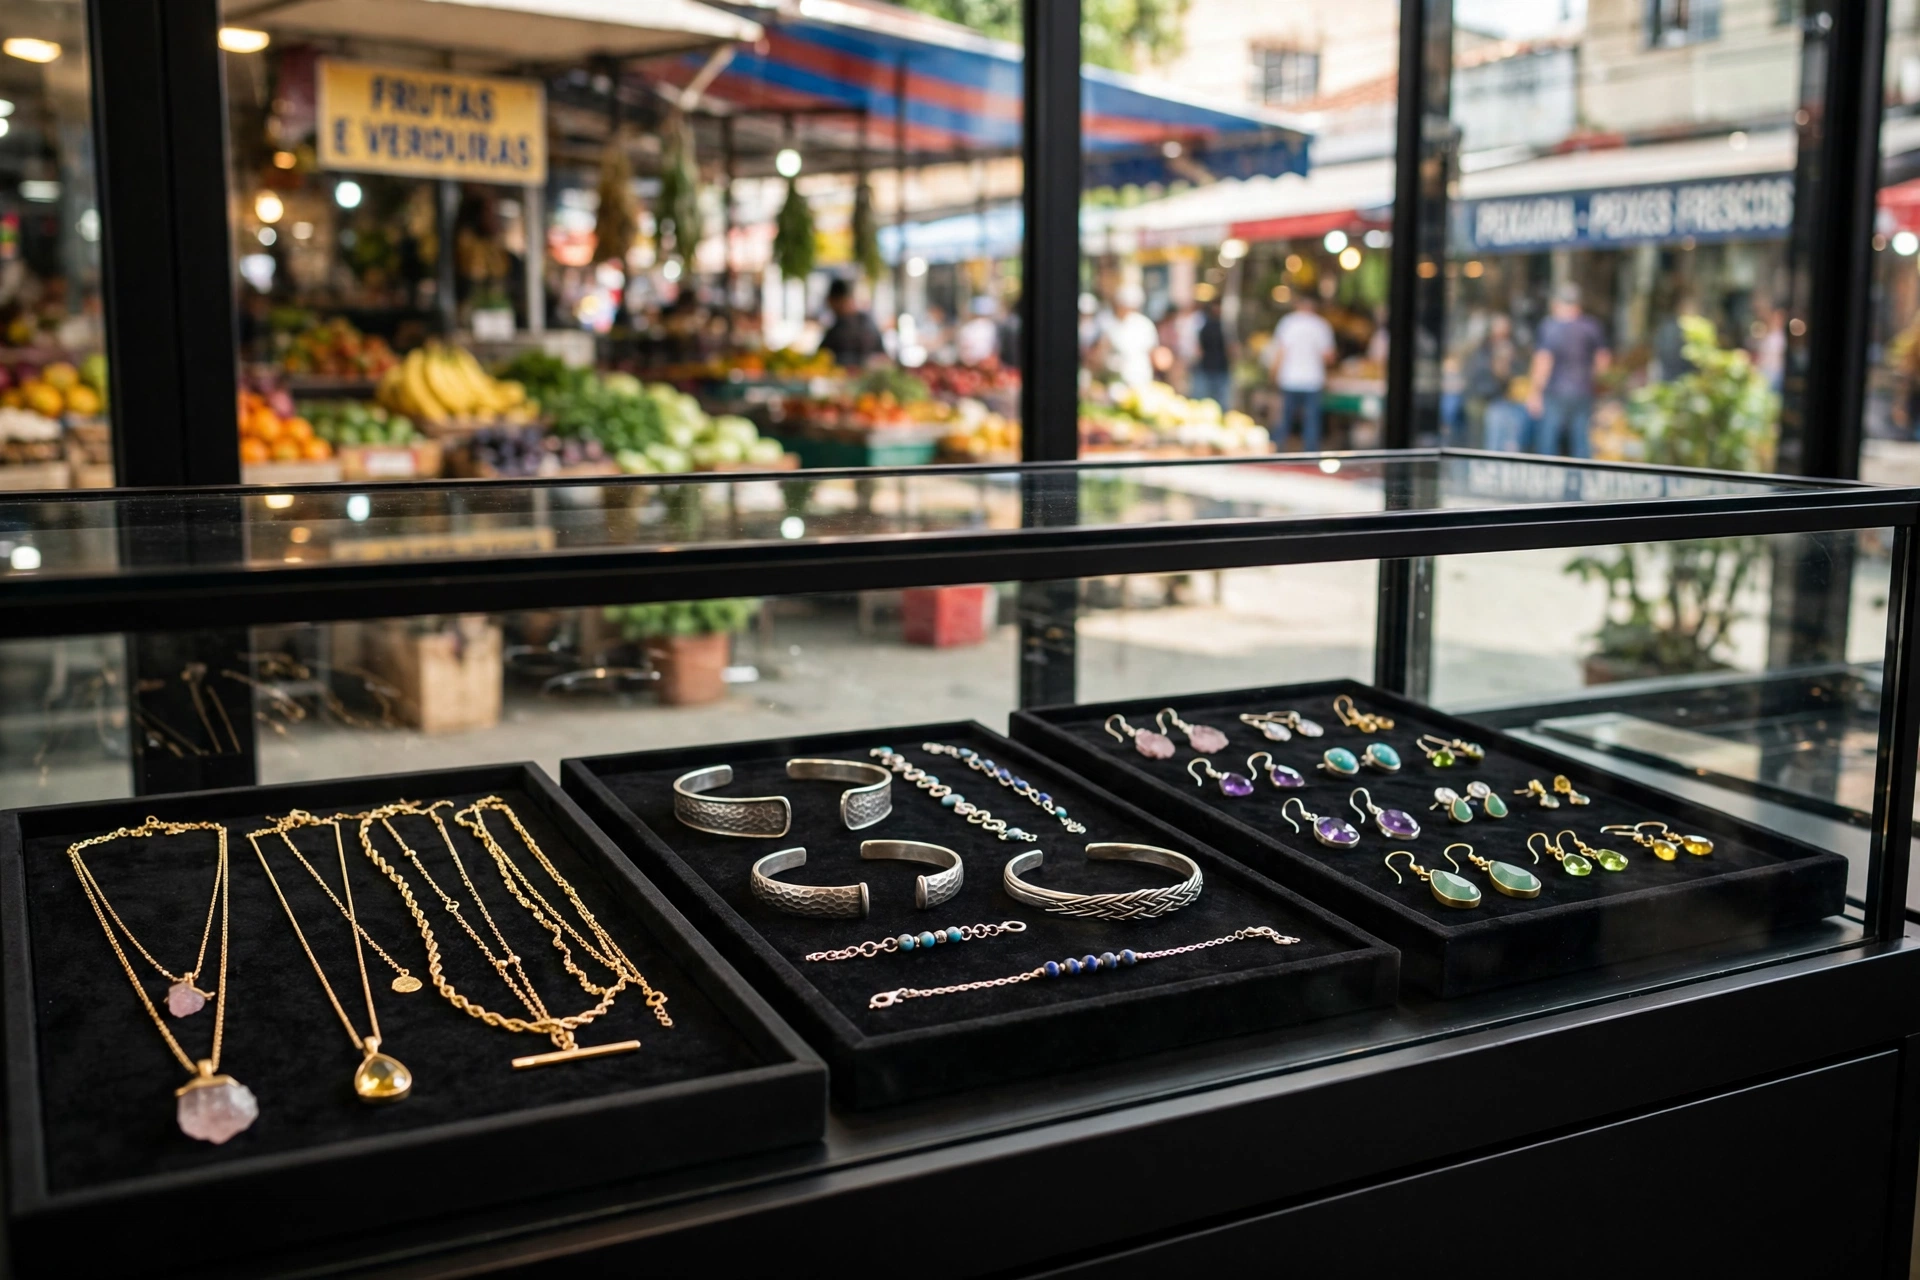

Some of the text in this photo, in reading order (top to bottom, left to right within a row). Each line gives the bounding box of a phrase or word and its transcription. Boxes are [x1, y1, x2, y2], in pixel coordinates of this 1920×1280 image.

[370, 75, 496, 122] FRUTAS
[333, 117, 531, 169] E VERDURAS
[1674, 178, 1795, 234] FRESCOS
